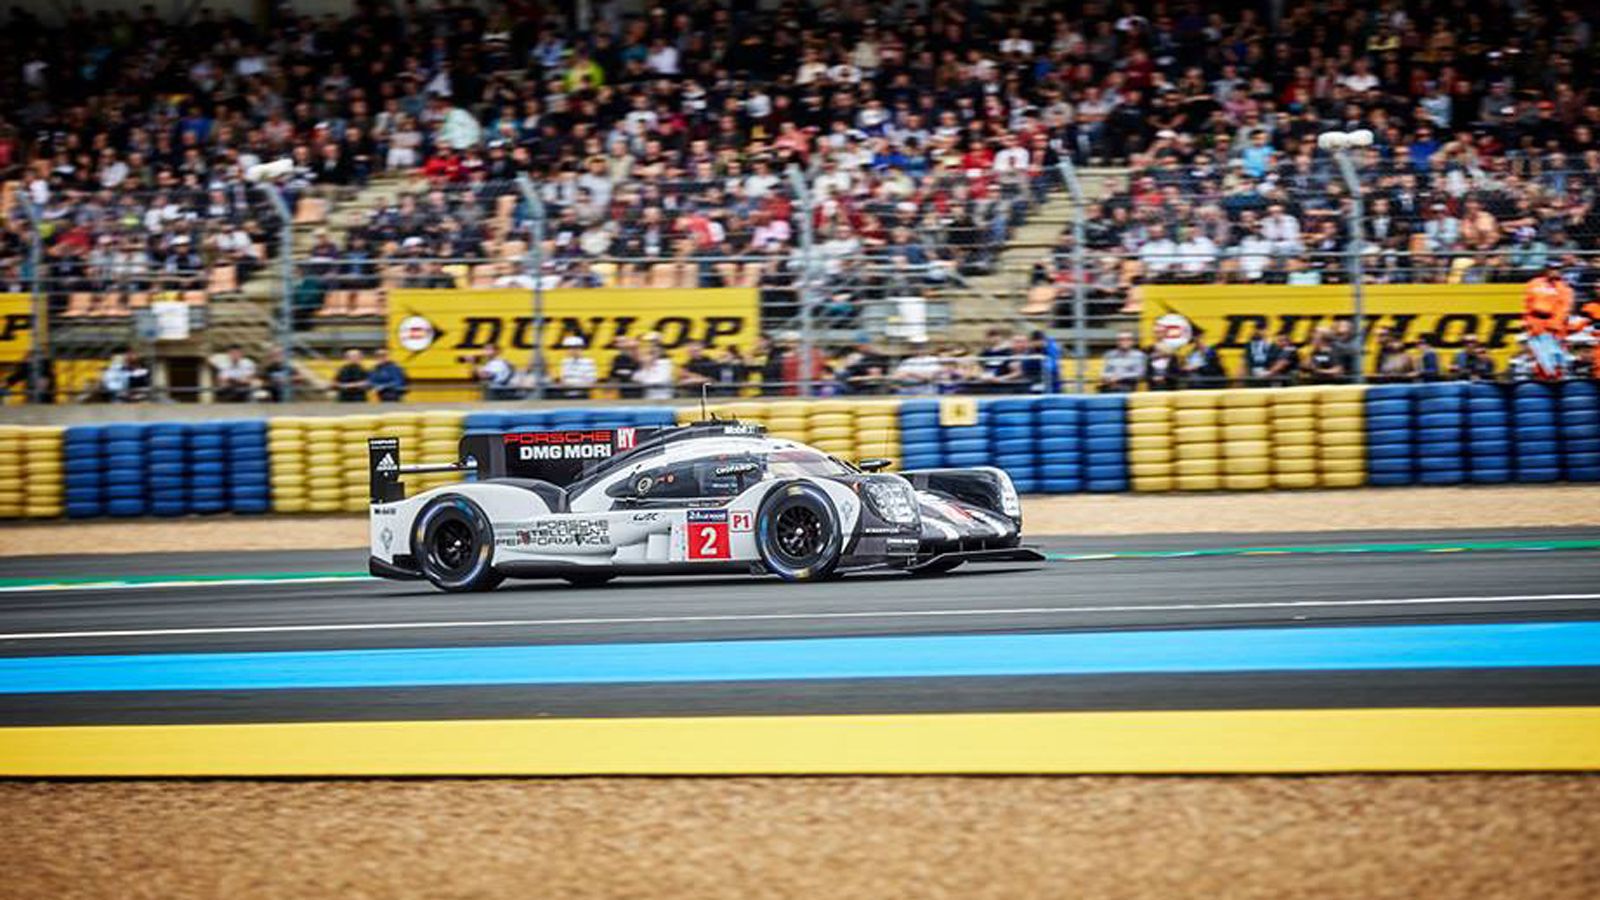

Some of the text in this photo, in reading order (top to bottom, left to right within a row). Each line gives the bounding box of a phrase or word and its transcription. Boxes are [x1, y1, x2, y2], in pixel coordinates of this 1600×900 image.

[503, 431, 611, 443] PORSCHE
[617, 428, 636, 449] HY
[520, 444, 611, 459] DMG MORI
[537, 520, 608, 530] PORSCHE
[733, 514, 749, 529] P1
[700, 526, 717, 556] 2
